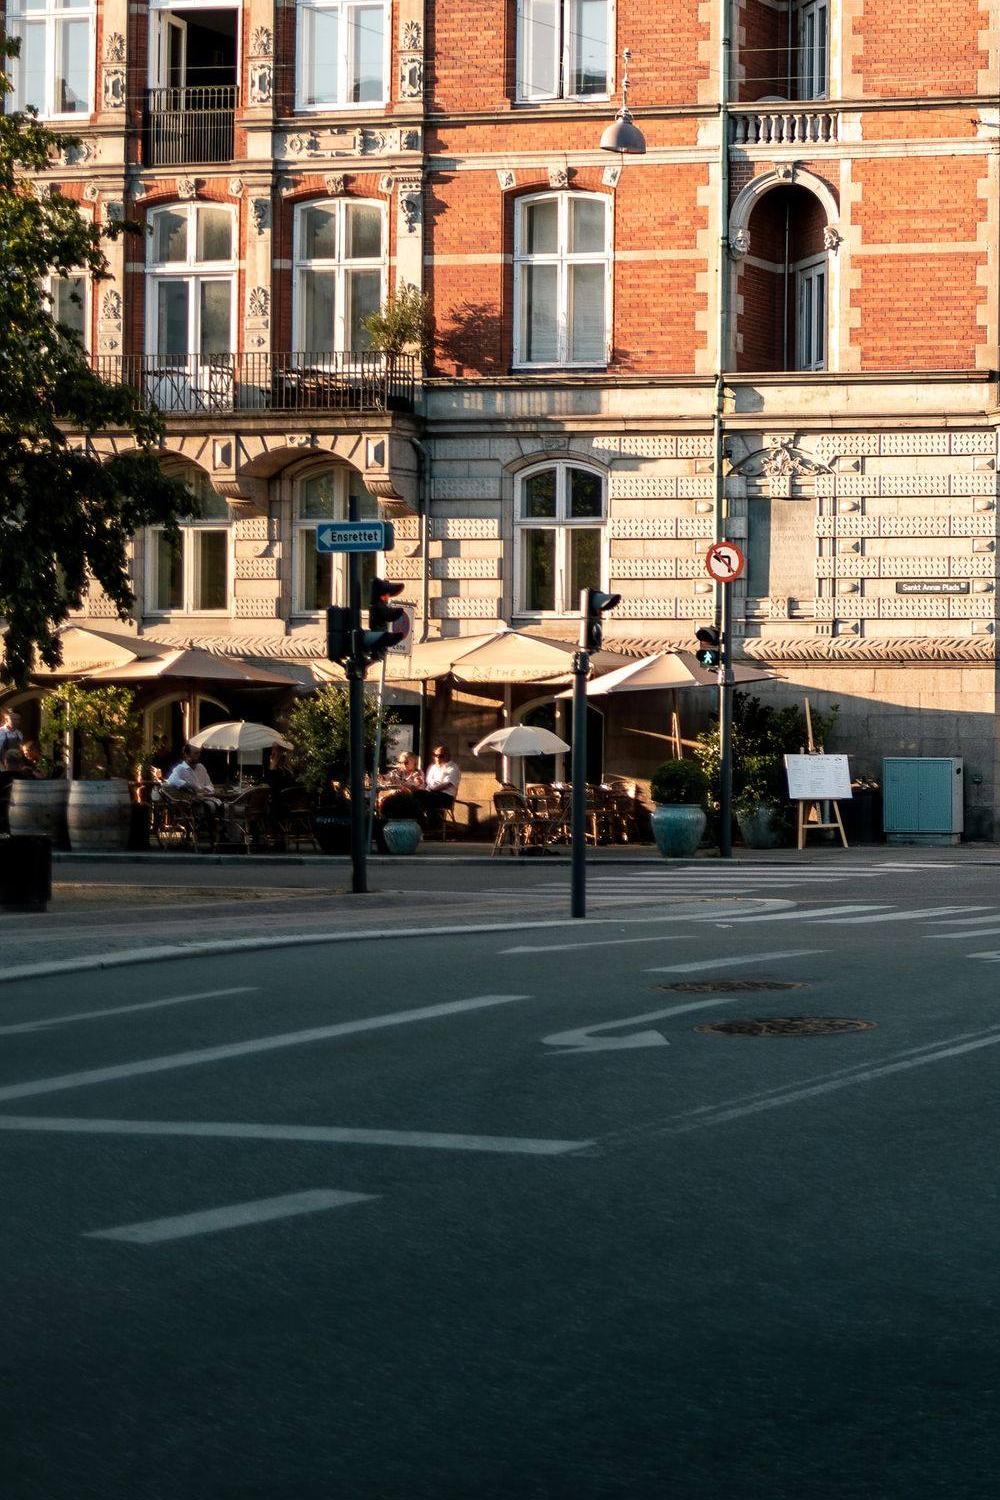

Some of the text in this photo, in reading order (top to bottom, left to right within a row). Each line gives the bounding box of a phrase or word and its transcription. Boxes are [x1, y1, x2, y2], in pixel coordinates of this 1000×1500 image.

[331, 531, 378, 542] Ensrettet
[902, 583, 922, 591] Sankt
[942, 583, 960, 591] Plads
